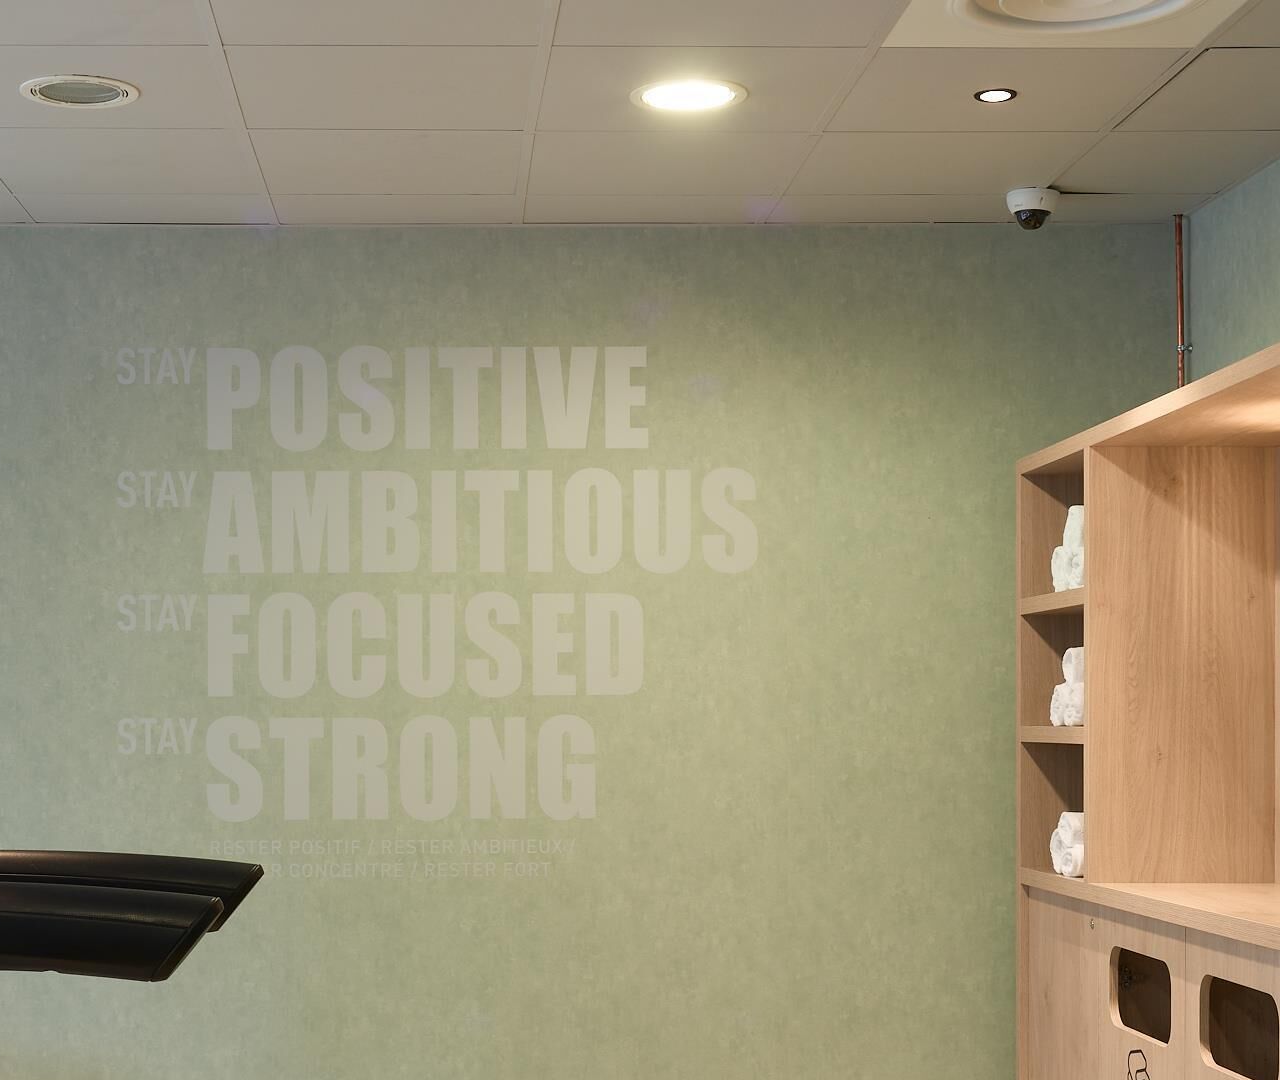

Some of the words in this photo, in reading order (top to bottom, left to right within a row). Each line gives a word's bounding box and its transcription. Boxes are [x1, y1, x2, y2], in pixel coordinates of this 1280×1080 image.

[117, 348, 197, 385] STAY
[206, 346, 648, 451] POSITIVE
[116, 470, 197, 509] STAY
[203, 467, 758, 574] AMBITIOUS
[117, 594, 197, 633] STAY
[207, 592, 643, 698] FOCUSED
[117, 717, 197, 755] STAY
[205, 715, 597, 821] STRONG
[210, 840, 282, 855] RESTER
[290, 840, 361, 855] POSITIF
[382, 840, 453, 854] RESTER
[461, 839, 562, 854] AMBITIEUX
[424, 863, 496, 877] RESTER
[504, 862, 551, 877] FORT
